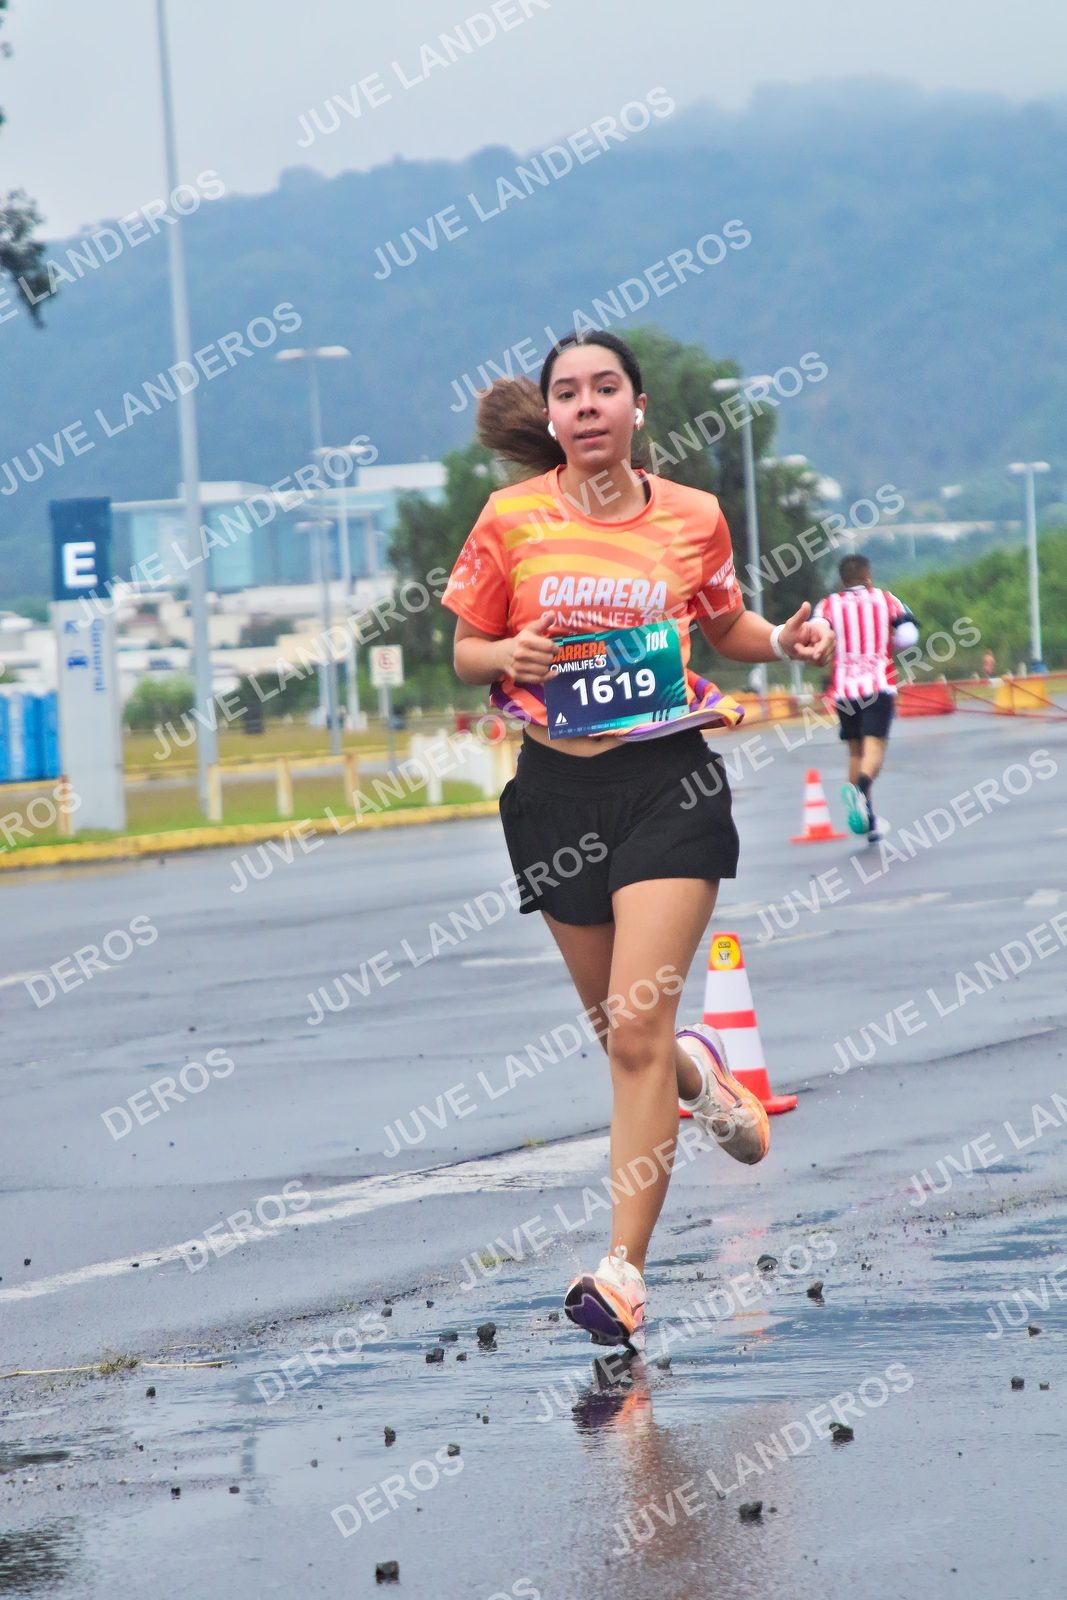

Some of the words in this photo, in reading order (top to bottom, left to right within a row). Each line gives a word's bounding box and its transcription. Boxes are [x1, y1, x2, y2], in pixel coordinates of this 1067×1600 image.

[62, 541, 98, 589] E
[539, 576, 667, 611] CARRERA
[552, 640, 606, 663] ARRERA
[645, 629, 669, 652] 10K
[572, 668, 656, 706] 1619
